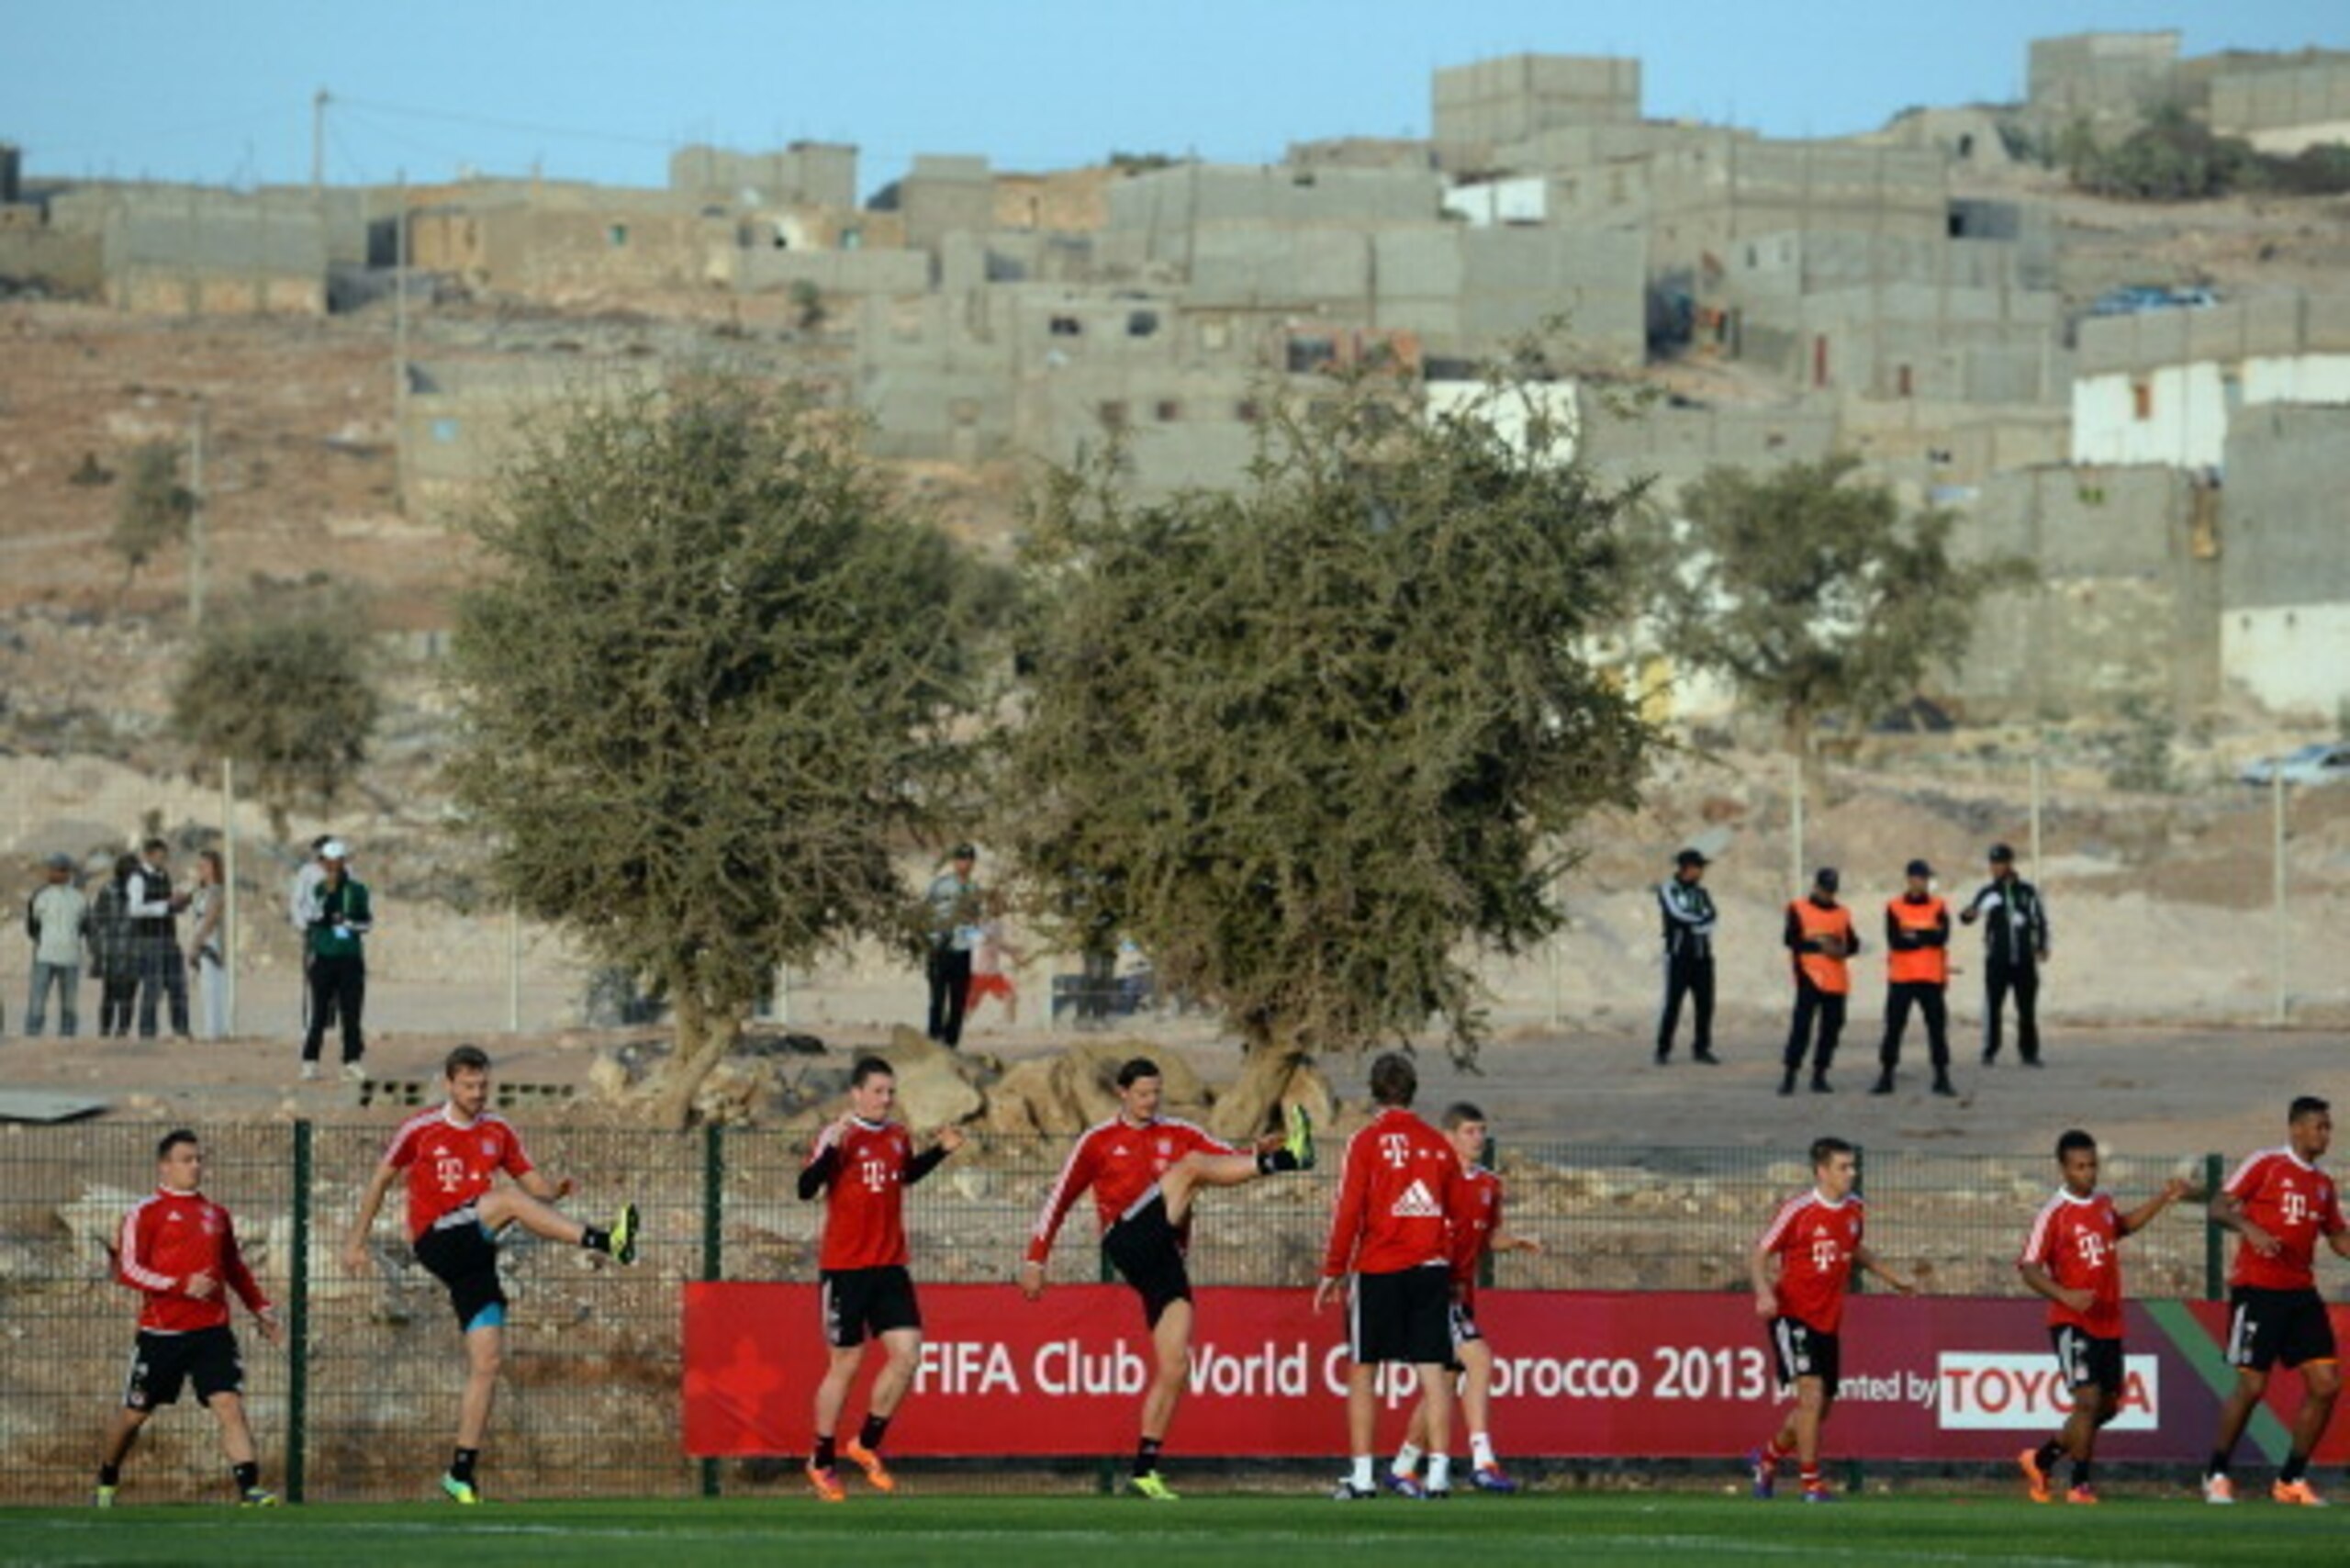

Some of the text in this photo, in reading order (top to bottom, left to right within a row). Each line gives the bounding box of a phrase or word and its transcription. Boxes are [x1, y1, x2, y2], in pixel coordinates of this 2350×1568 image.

[914, 1341, 1020, 1394] FIFA
[1034, 1338, 1146, 1394] Club
[1457, 1358, 1639, 1397] orocco
[1653, 1347, 1766, 1398] 2013
[1908, 1371, 1939, 1408] by
[1943, 1368, 2153, 1414] TOYOA
